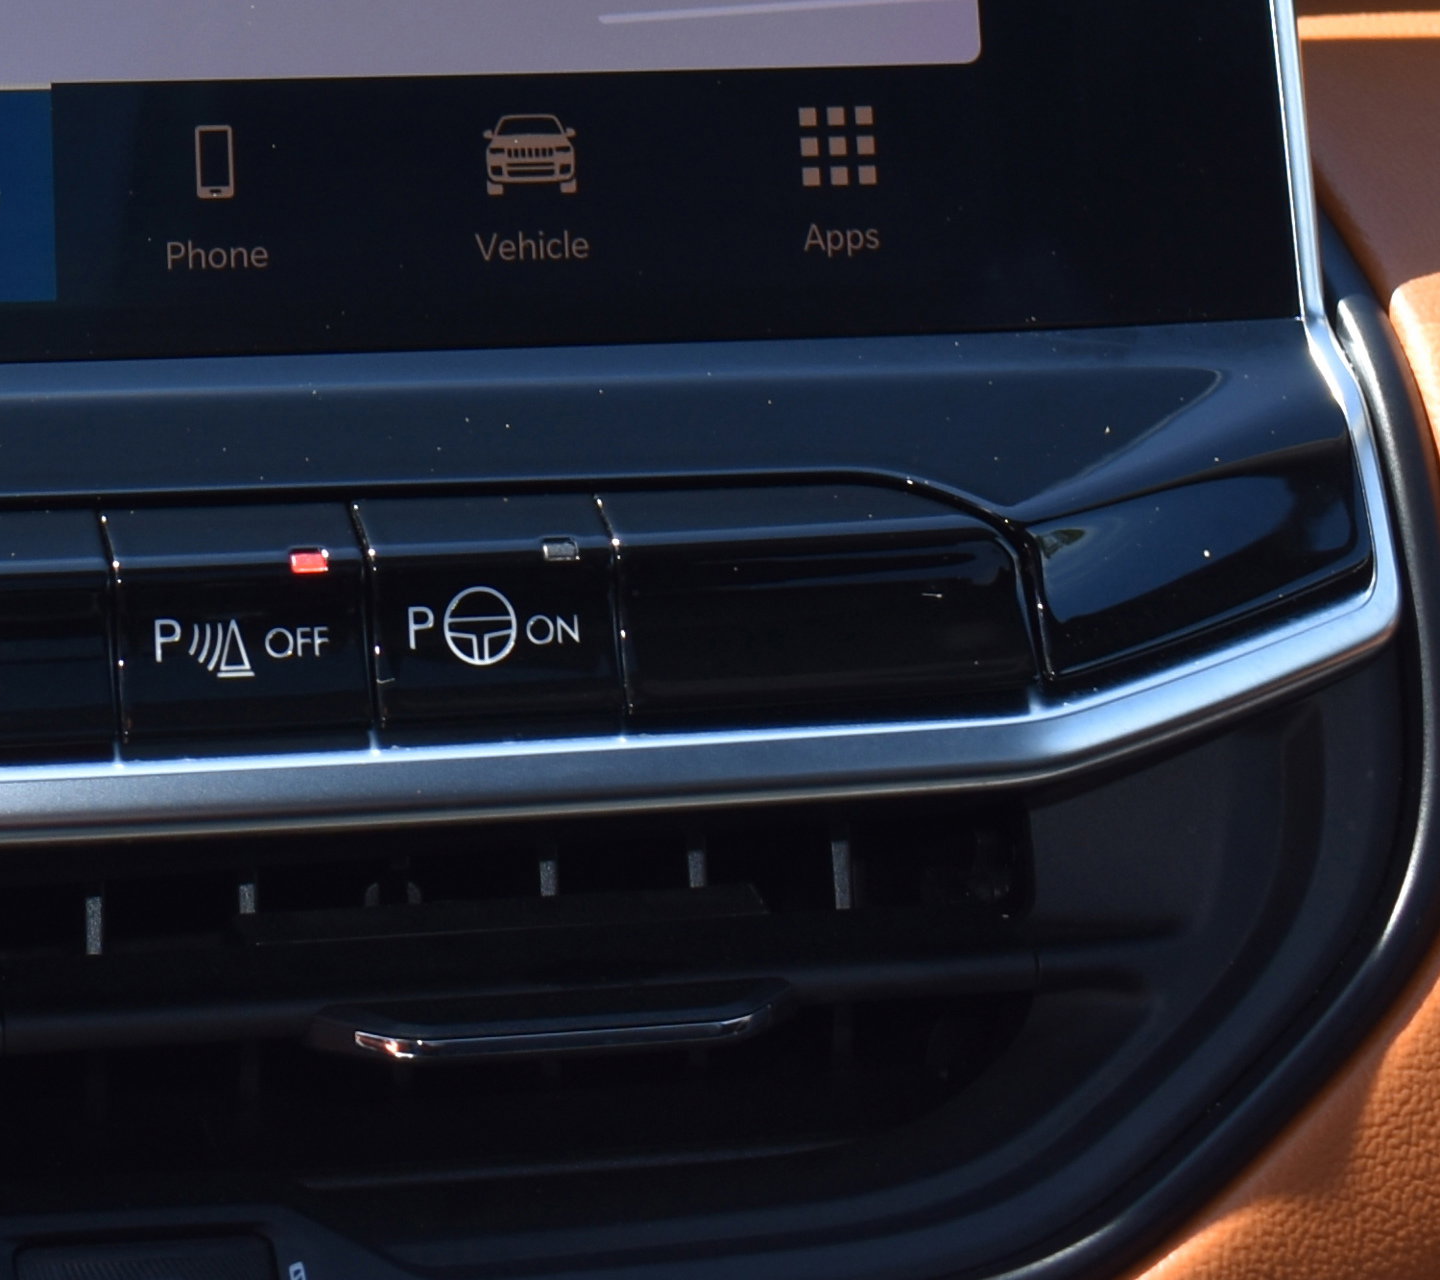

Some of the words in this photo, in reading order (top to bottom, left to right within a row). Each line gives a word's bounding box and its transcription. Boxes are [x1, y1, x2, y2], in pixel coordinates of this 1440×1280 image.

[166, 239, 269, 270] Phone
[474, 229, 589, 261] Vehicle
[804, 223, 880, 257] Apps
[154, 618, 182, 663] P
[264, 626, 329, 658] OFF
[408, 606, 435, 650] P
[526, 614, 580, 645] ON
